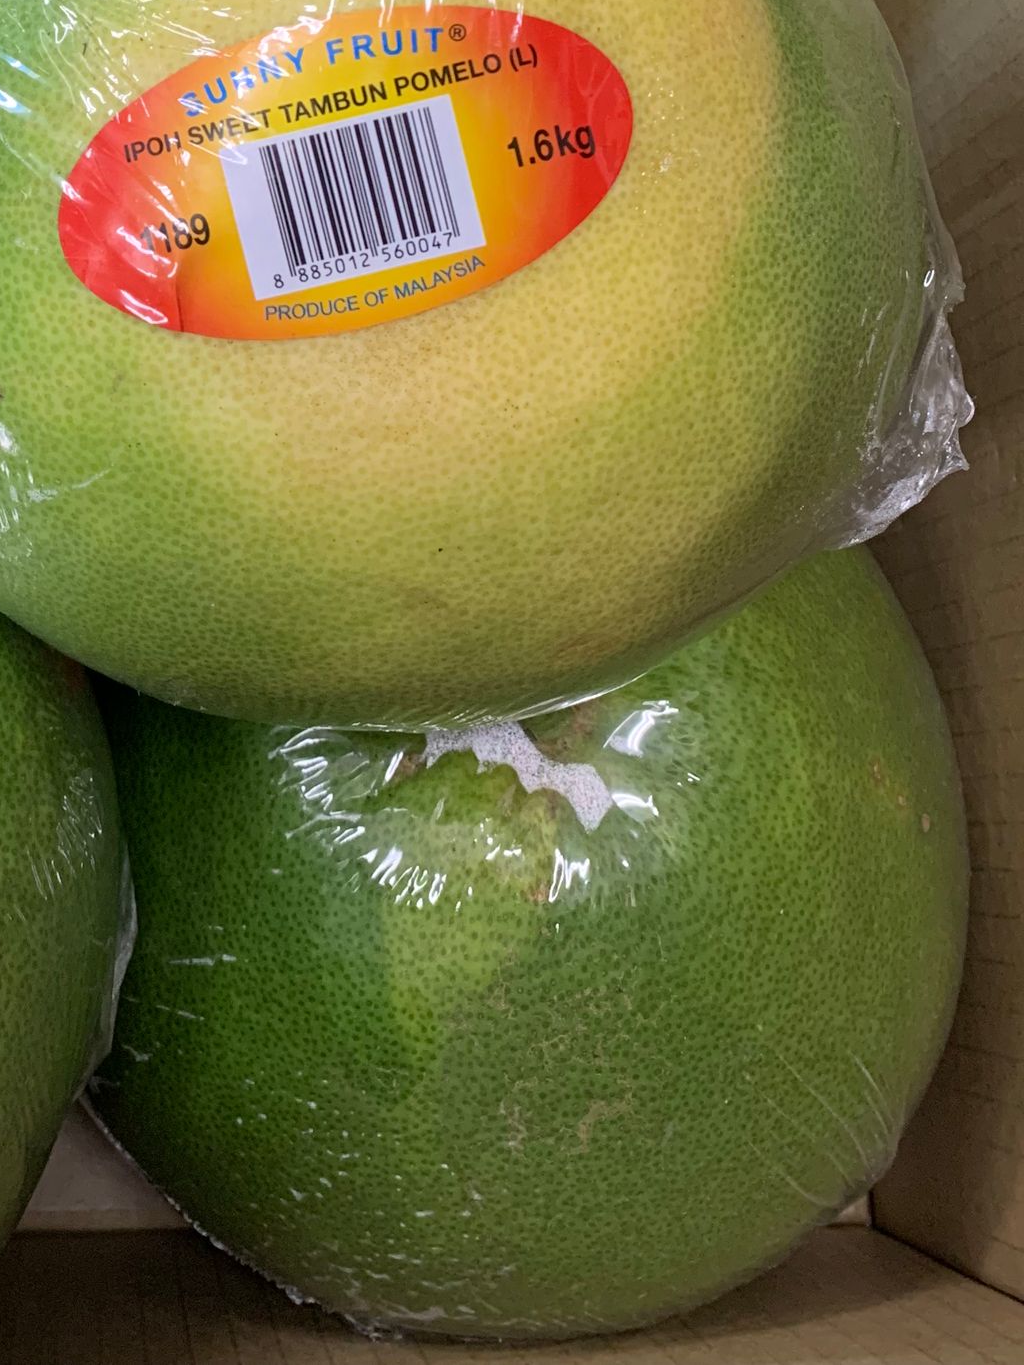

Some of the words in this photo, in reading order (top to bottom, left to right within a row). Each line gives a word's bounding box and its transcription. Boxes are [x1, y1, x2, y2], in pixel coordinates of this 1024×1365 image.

[123, 131, 183, 164] IPOH
[187, 108, 272, 146] SWEET
[278, 82, 387, 124] TAMBUN
[394, 53, 502, 96] POMELO
[508, 43, 538, 72] (L)
[179, 47, 307, 119] SUNNY
[506, 124, 597, 168] 1.6kg
[139, 213, 211, 255] 1189
[273, 273, 284, 289] 8
[298, 251, 372, 284] 885012
[381, 231, 454, 264] 560047
[264, 298, 360, 322] PRODUCE
[362, 291, 388, 308] OF
[392, 254, 487, 298] MALAYSIA
